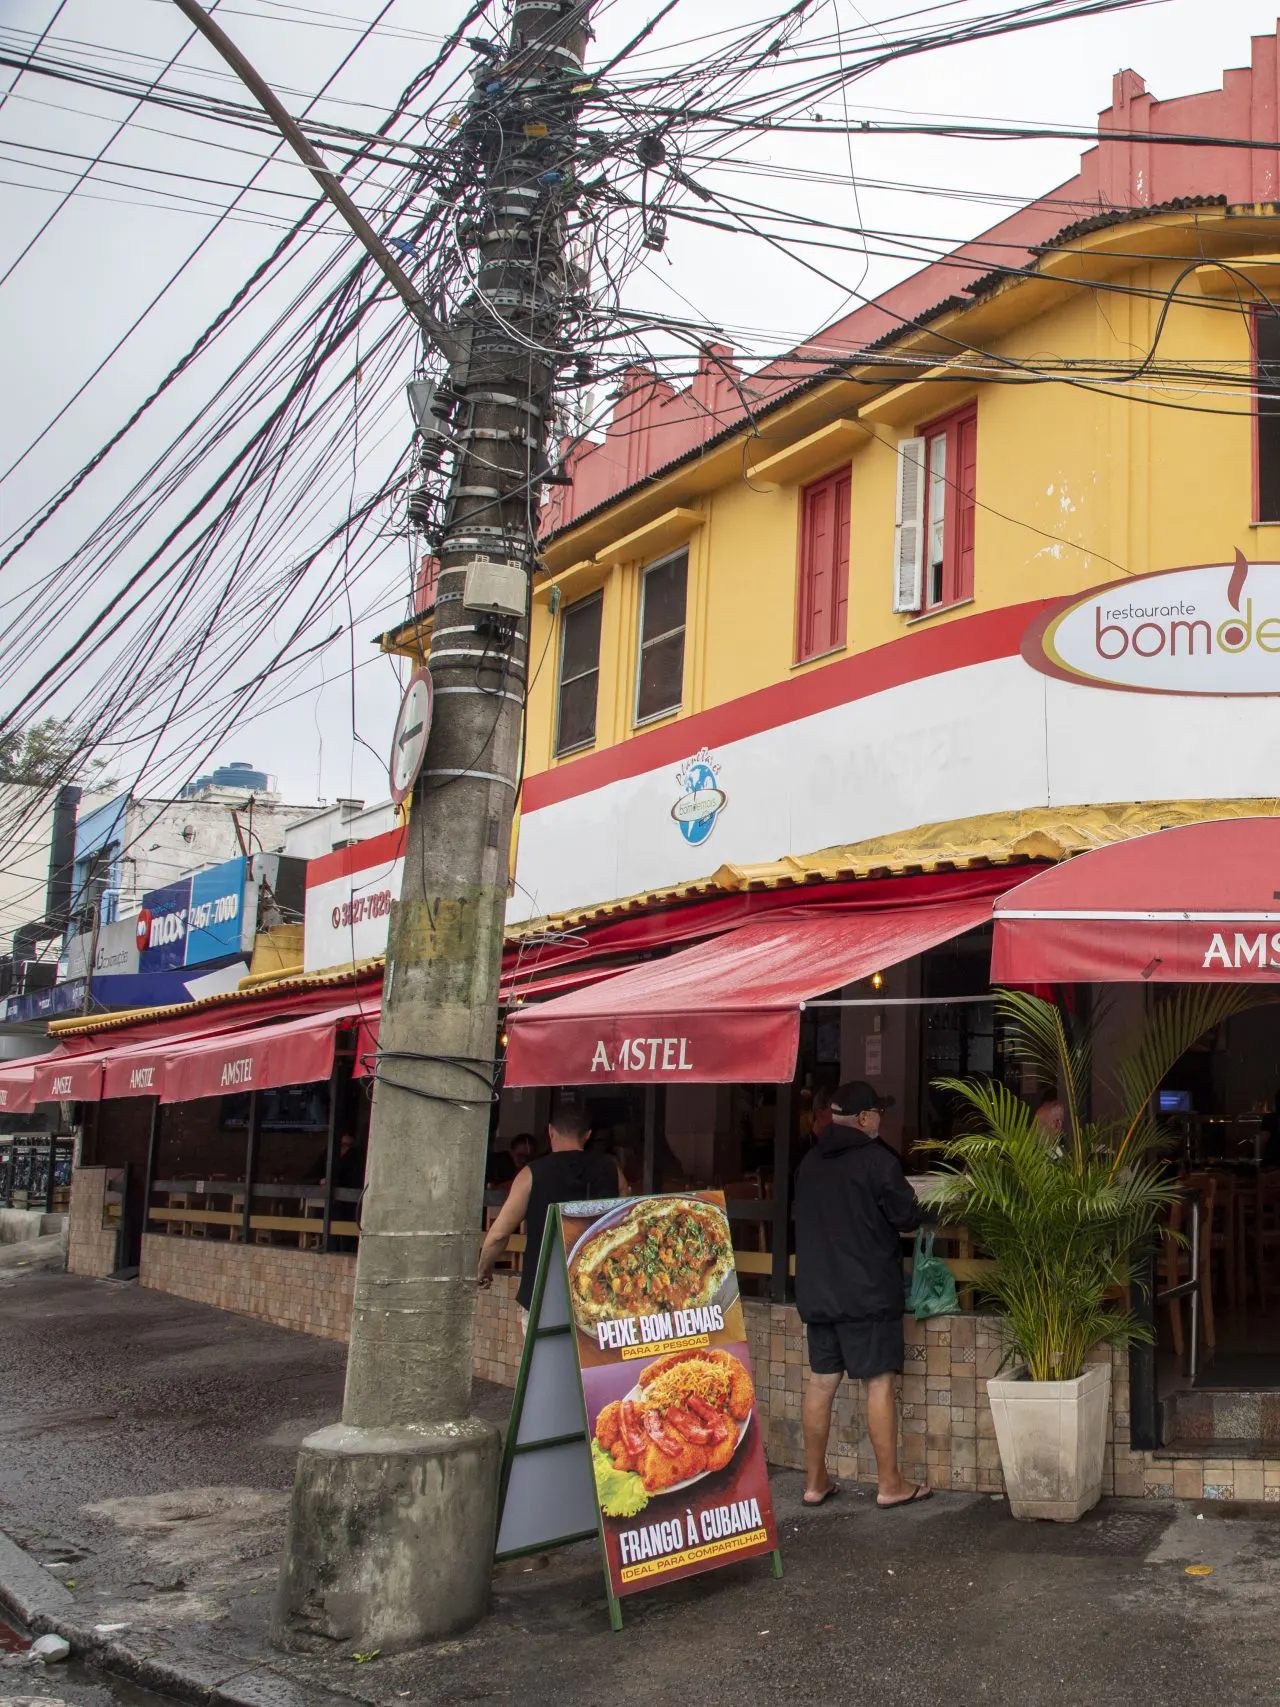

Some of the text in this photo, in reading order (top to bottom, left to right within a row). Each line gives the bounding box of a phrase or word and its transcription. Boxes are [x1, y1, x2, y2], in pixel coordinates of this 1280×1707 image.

[1105, 600, 1196, 620] restaurante
[149, 908, 188, 949] max
[220, 1058, 253, 1087] AMSTEL
[590, 1037, 693, 1072] AMSTEL
[596, 1304, 724, 1350] PEIXE BOM DEMAIS
[623, 1346, 651, 1357] PARA
[663, 1336, 708, 1351] PESSOAS
[619, 1497, 763, 1565] FRANGO À CUBANA
[623, 1531, 766, 1580] IDEAL PARA COMPARTILHAR
